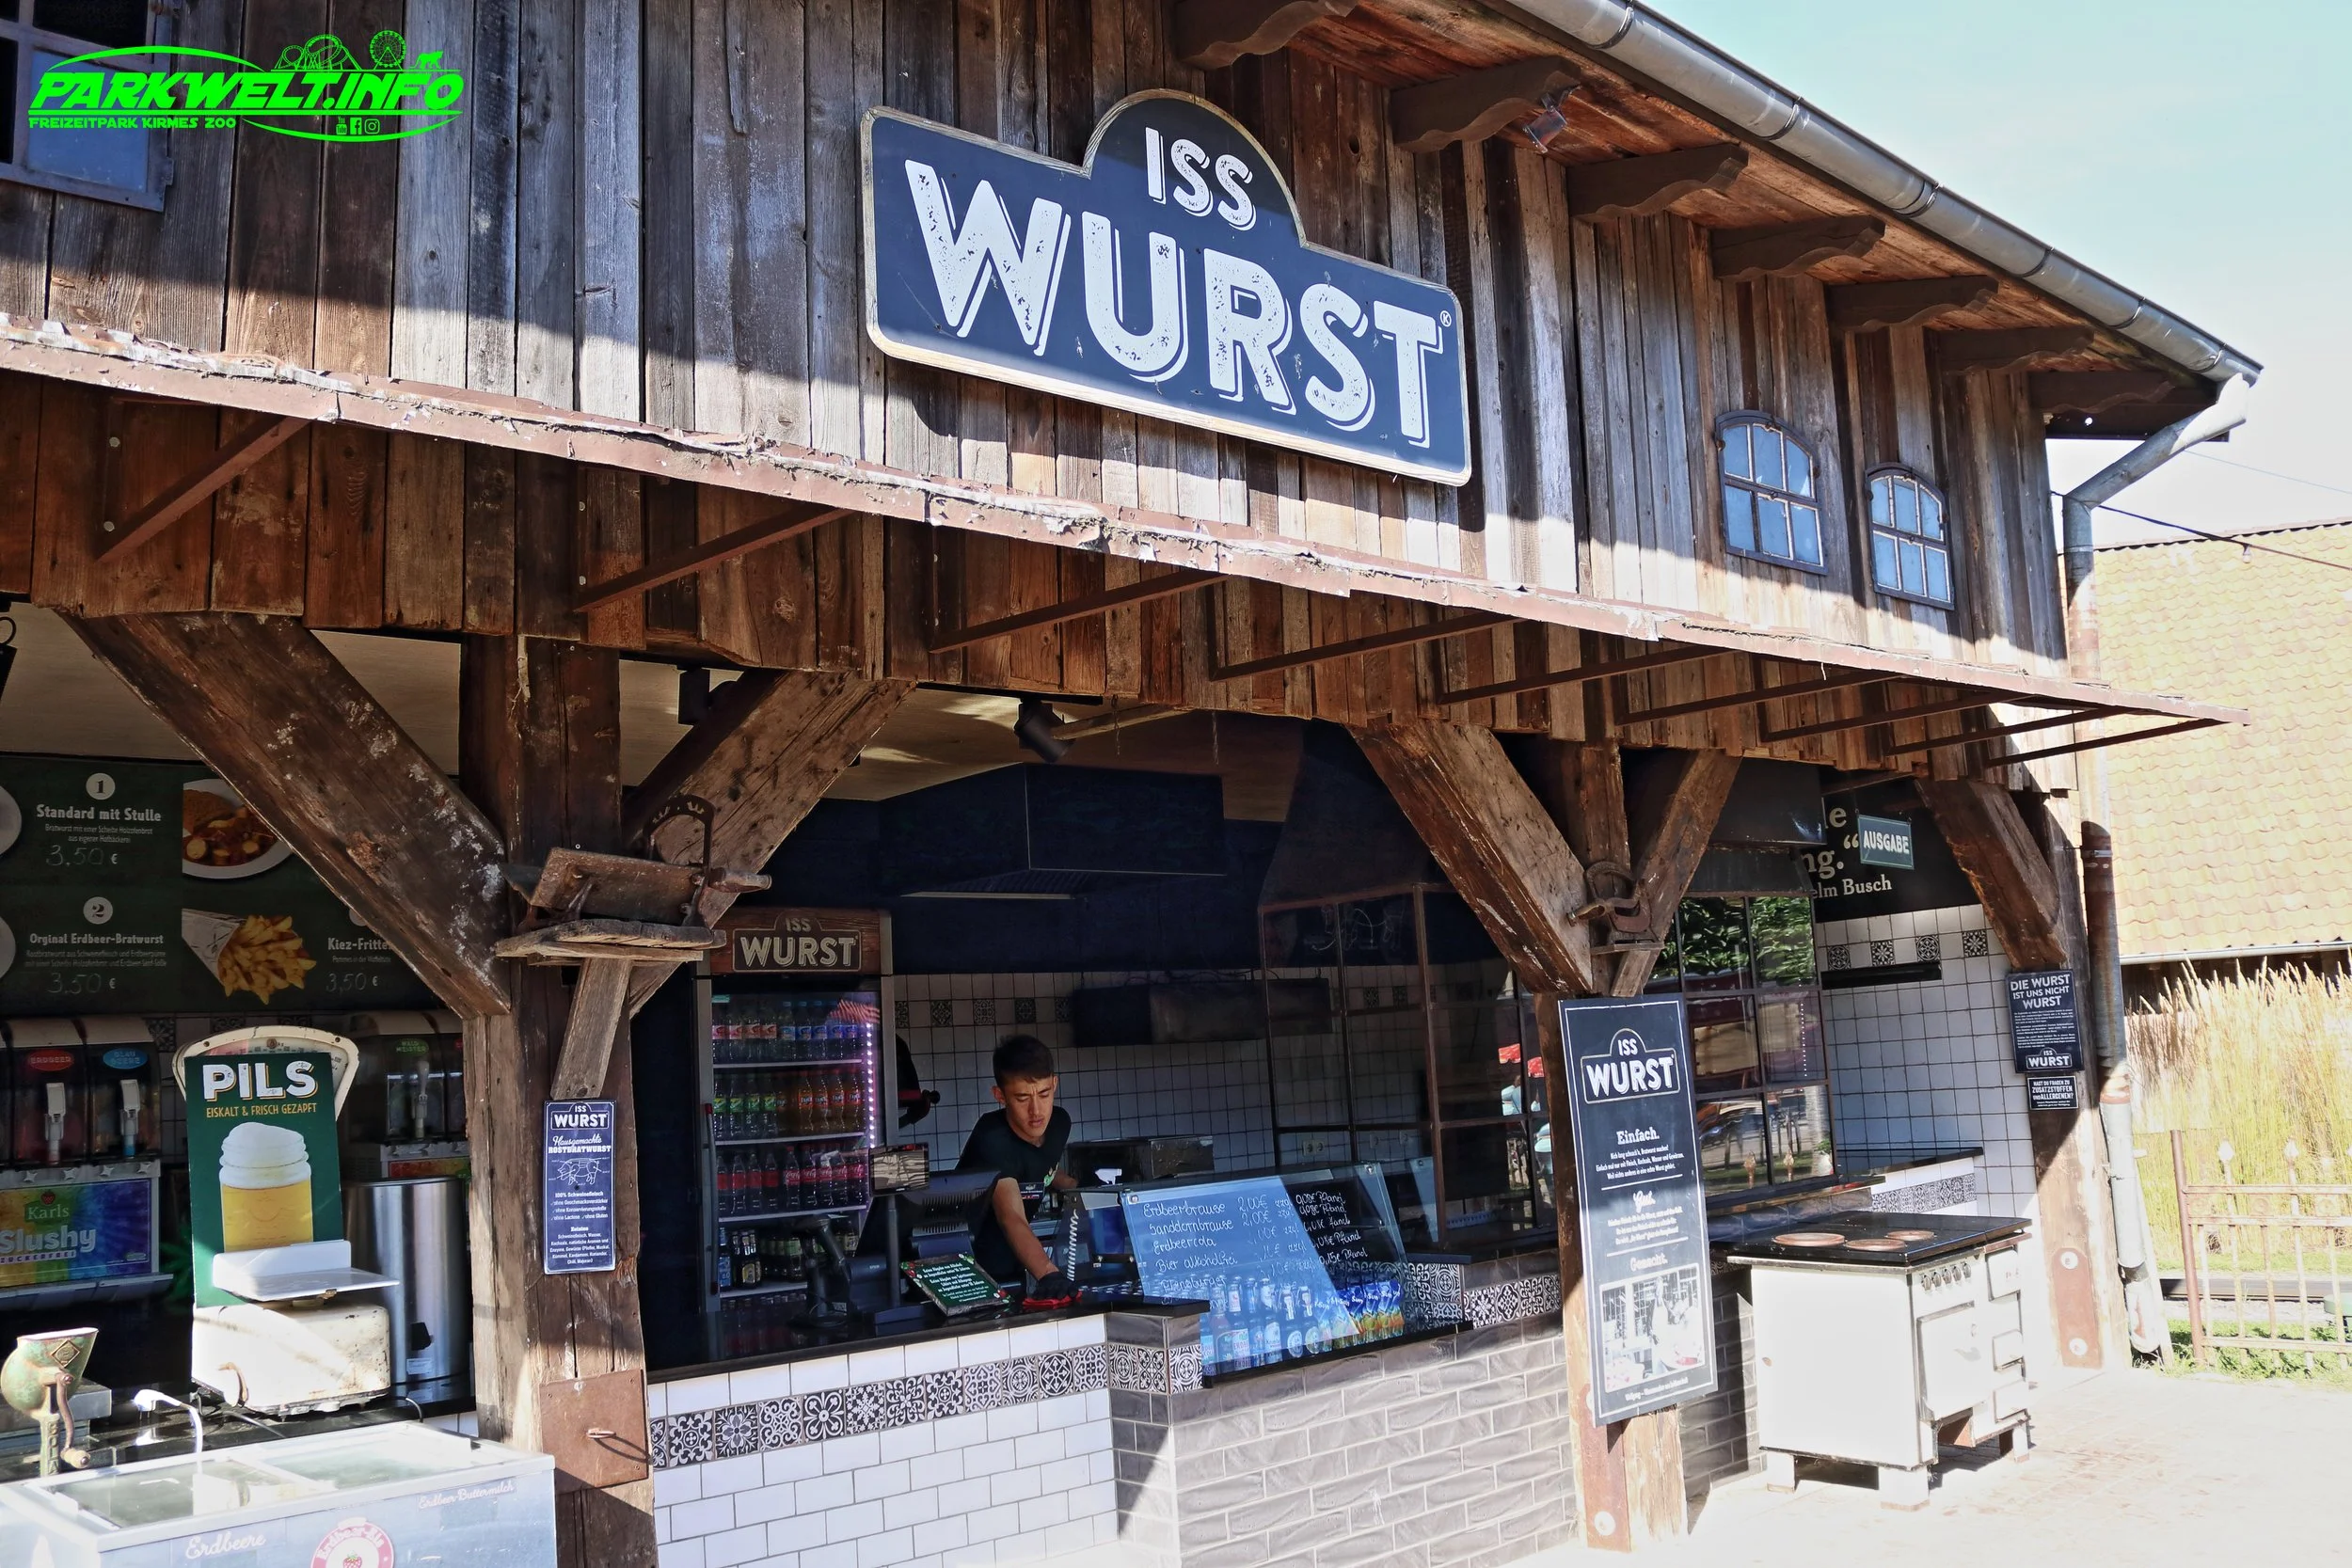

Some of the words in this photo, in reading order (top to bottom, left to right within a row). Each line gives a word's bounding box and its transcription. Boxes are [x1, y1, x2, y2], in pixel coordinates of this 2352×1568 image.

[1146, 126, 1256, 231] ISS
[904, 159, 1444, 449] WURST
[36, 804, 94, 819] Standard
[99, 810, 120, 820] mit
[124, 807, 162, 822] Stulle
[1863, 831, 1910, 854] AUSGABE
[1842, 874, 1892, 895] Busch
[785, 918, 812, 931] ISS
[29, 933, 68, 945] Orginal
[71, 933, 164, 944] Erdbeer-Bratwurst
[327, 938, 392, 950] Kiez-Fritte
[740, 937, 857, 967] WURST
[2010, 979, 2029, 991] DIE
[2031, 974, 2070, 989] WURST
[2013, 991, 2025, 1000] IST
[2026, 989, 2043, 998] UNS
[2044, 985, 2069, 996] NICHT
[2023, 995, 2061, 1010] WURST
[1617, 1037, 1638, 1056] ISS
[2028, 1055, 2070, 1068] WURST
[202, 1060, 319, 1102] PILS
[1586, 1056, 1674, 1098] WURST
[2031, 1085, 2074, 1094] ZUSATZSTOFFEN
[206, 1106, 240, 1117] EISKALT
[242, 1105, 248, 1117] &
[251, 1104, 278, 1116] FRISCH
[281, 1102, 317, 1114] GEZAPFT
[575, 1104, 587, 1113] ISS
[554, 1114, 608, 1128] WURST
[1616, 1127, 1660, 1145] Einfach.
[548, 1145, 612, 1154] ROSTBRATWURST
[27, 1204, 70, 1221] Karls
[1143, 1200, 1226, 1220] Erdbeerbrause
[1149, 1217, 1235, 1235] Sanddornbrause
[0, 1226, 96, 1253] Slushy
[1152, 1235, 1217, 1255] Erdbeercola
[0, 1251, 75, 1263] ZUCKERFREI
[1154, 1259, 1179, 1273] Bier
[419, 1480, 515, 1510] Erdbeer-Buttermilch
[185, 1531, 266, 1560] Erdbeere
